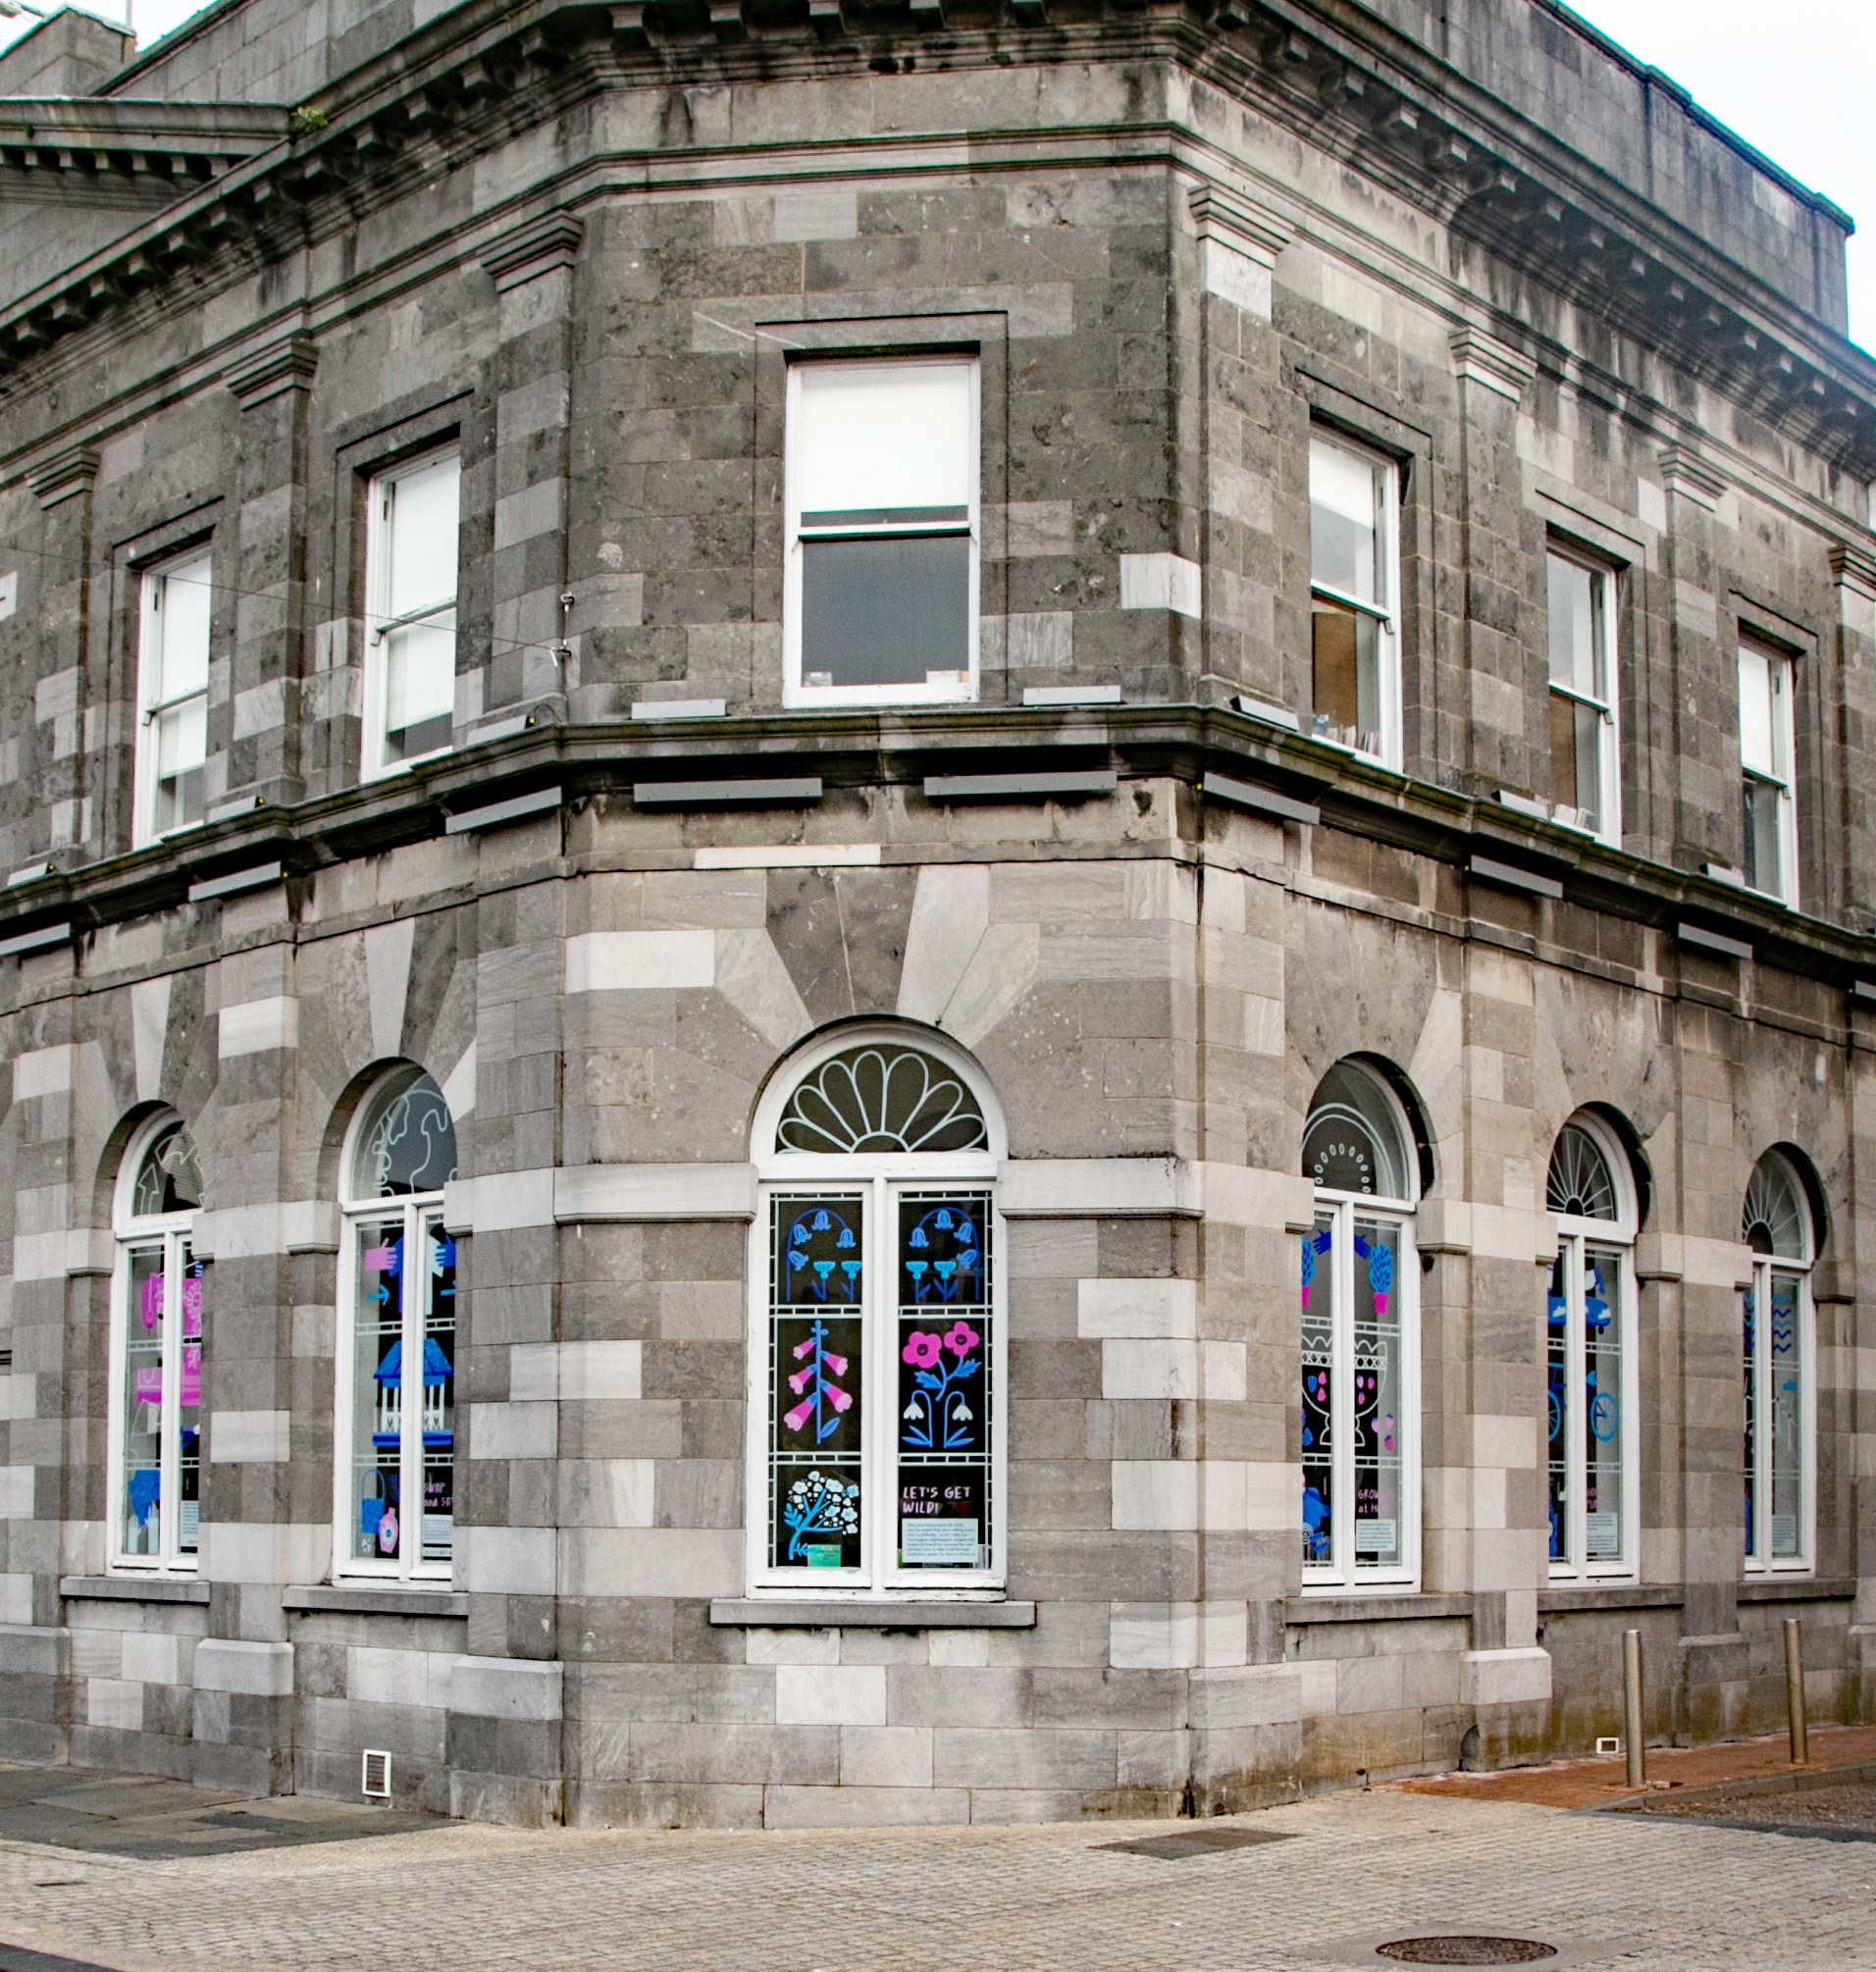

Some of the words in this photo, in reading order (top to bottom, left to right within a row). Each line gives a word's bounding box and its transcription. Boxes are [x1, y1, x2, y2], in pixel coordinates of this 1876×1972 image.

[423, 1482, 445, 1493] SWAP
[903, 1486, 939, 1499] LET'S
[944, 1486, 971, 1499] GET
[902, 1501, 939, 1514] WILD!
[1358, 1503, 1369, 1514] at
